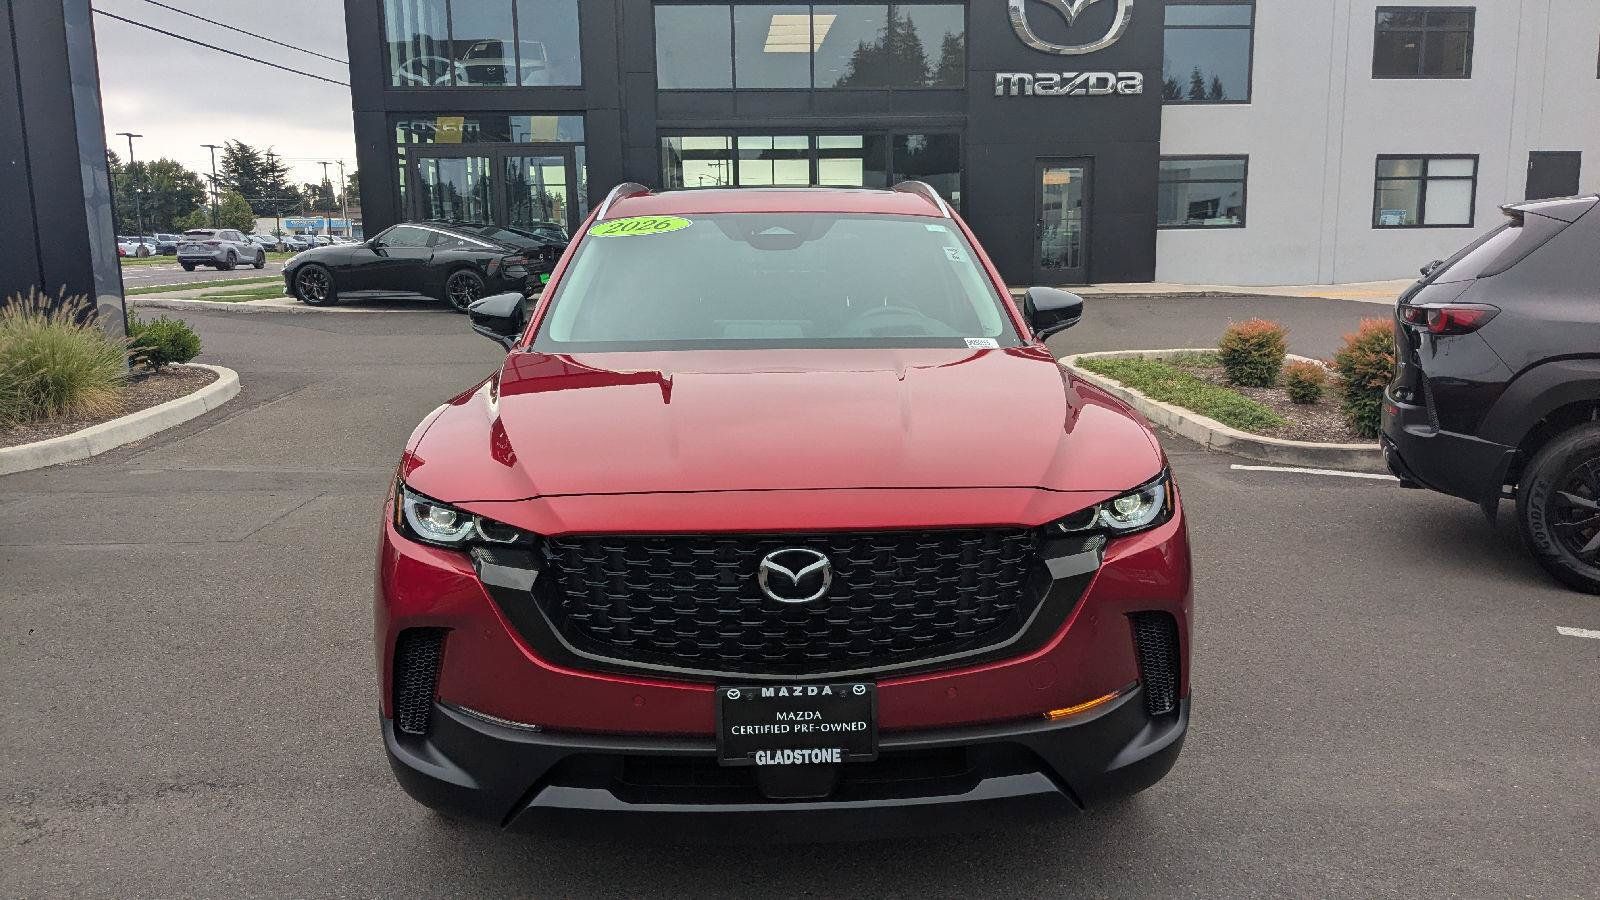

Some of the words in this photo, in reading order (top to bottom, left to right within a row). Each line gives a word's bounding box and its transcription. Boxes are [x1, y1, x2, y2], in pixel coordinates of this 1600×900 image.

[602, 219, 671, 234] 2026
[761, 685, 833, 698] MAZDA
[776, 710, 823, 721] MAZDA
[731, 724, 790, 735] CERTIFIED
[794, 721, 867, 733] PRE-OWNED
[755, 748, 842, 766] GLADSTONE
